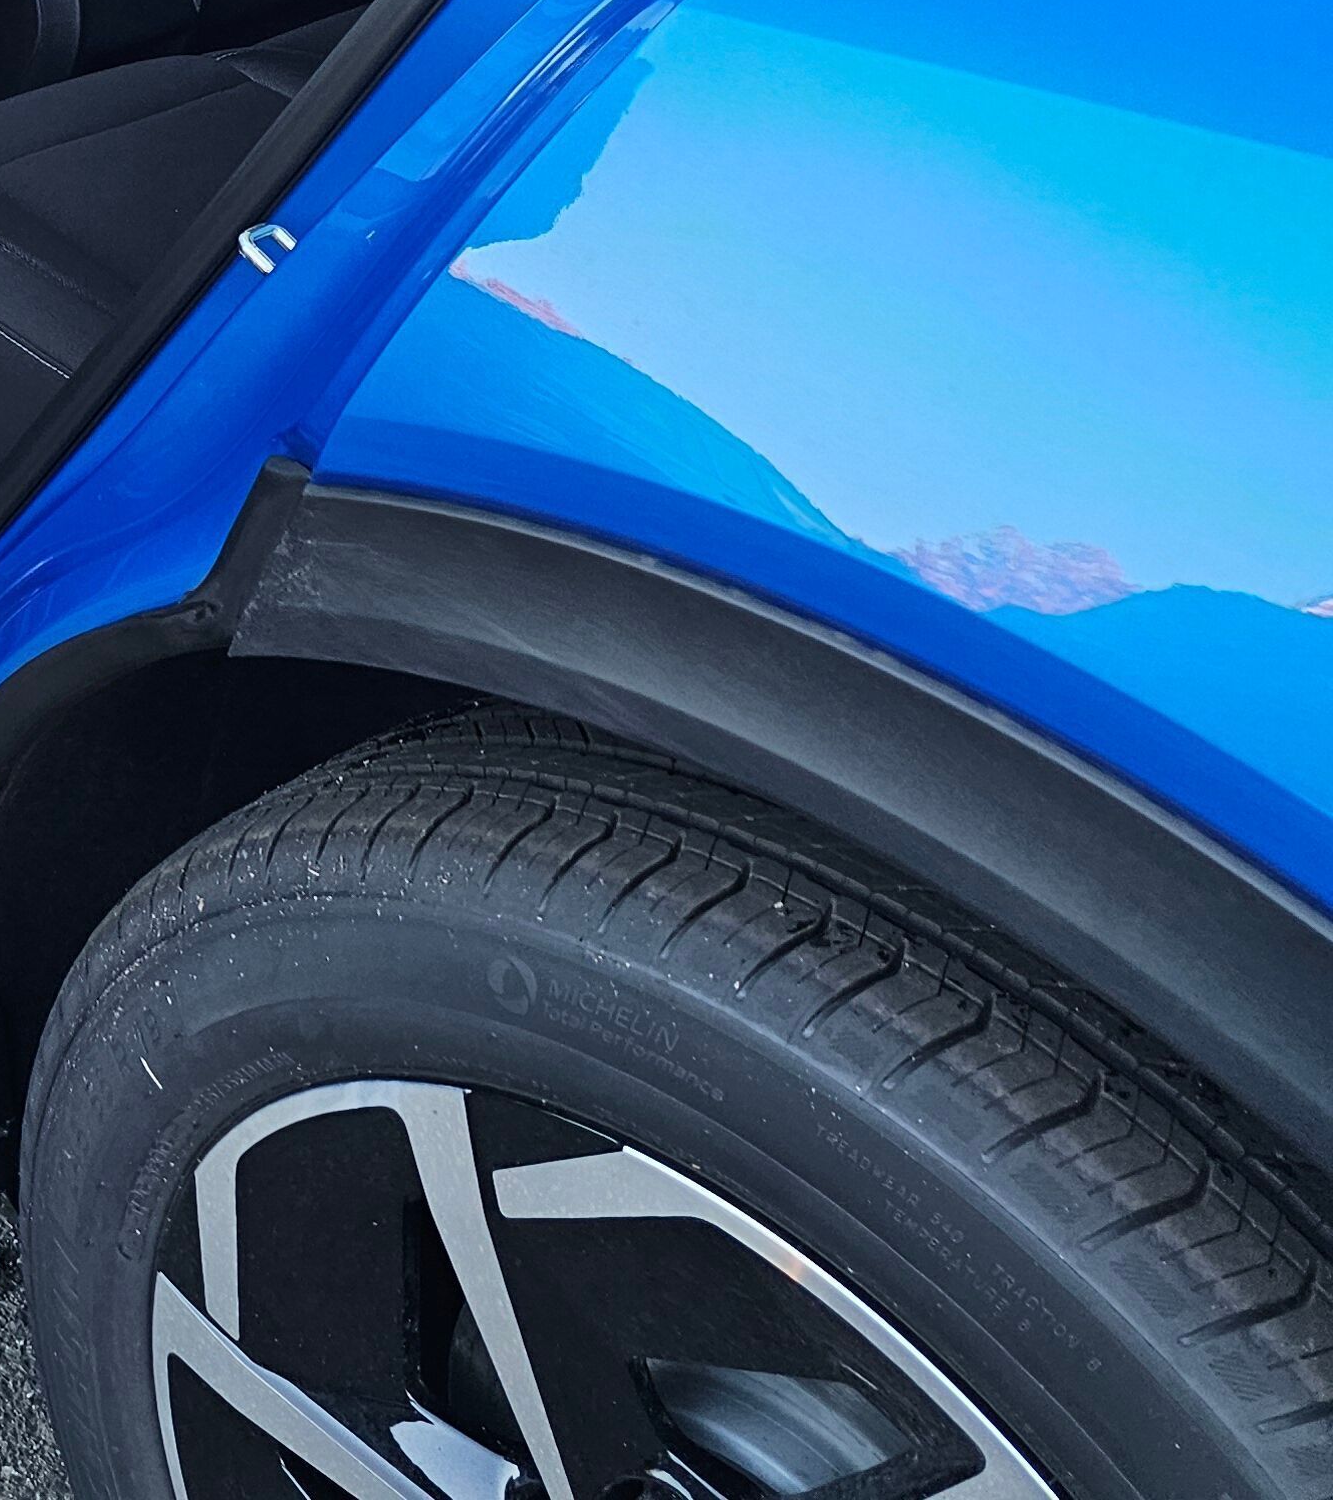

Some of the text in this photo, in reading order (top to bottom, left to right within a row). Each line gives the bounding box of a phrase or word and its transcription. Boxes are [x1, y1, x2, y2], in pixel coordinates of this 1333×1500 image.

[543, 1000, 725, 1102] Total Performance
[547, 979, 680, 1052] MICHELIN
[815, 1121, 921, 1208] TREADWEAR
[991, 1262, 1081, 1349] TRACTION
[884, 1198, 1010, 1317] TEMPERATURE
